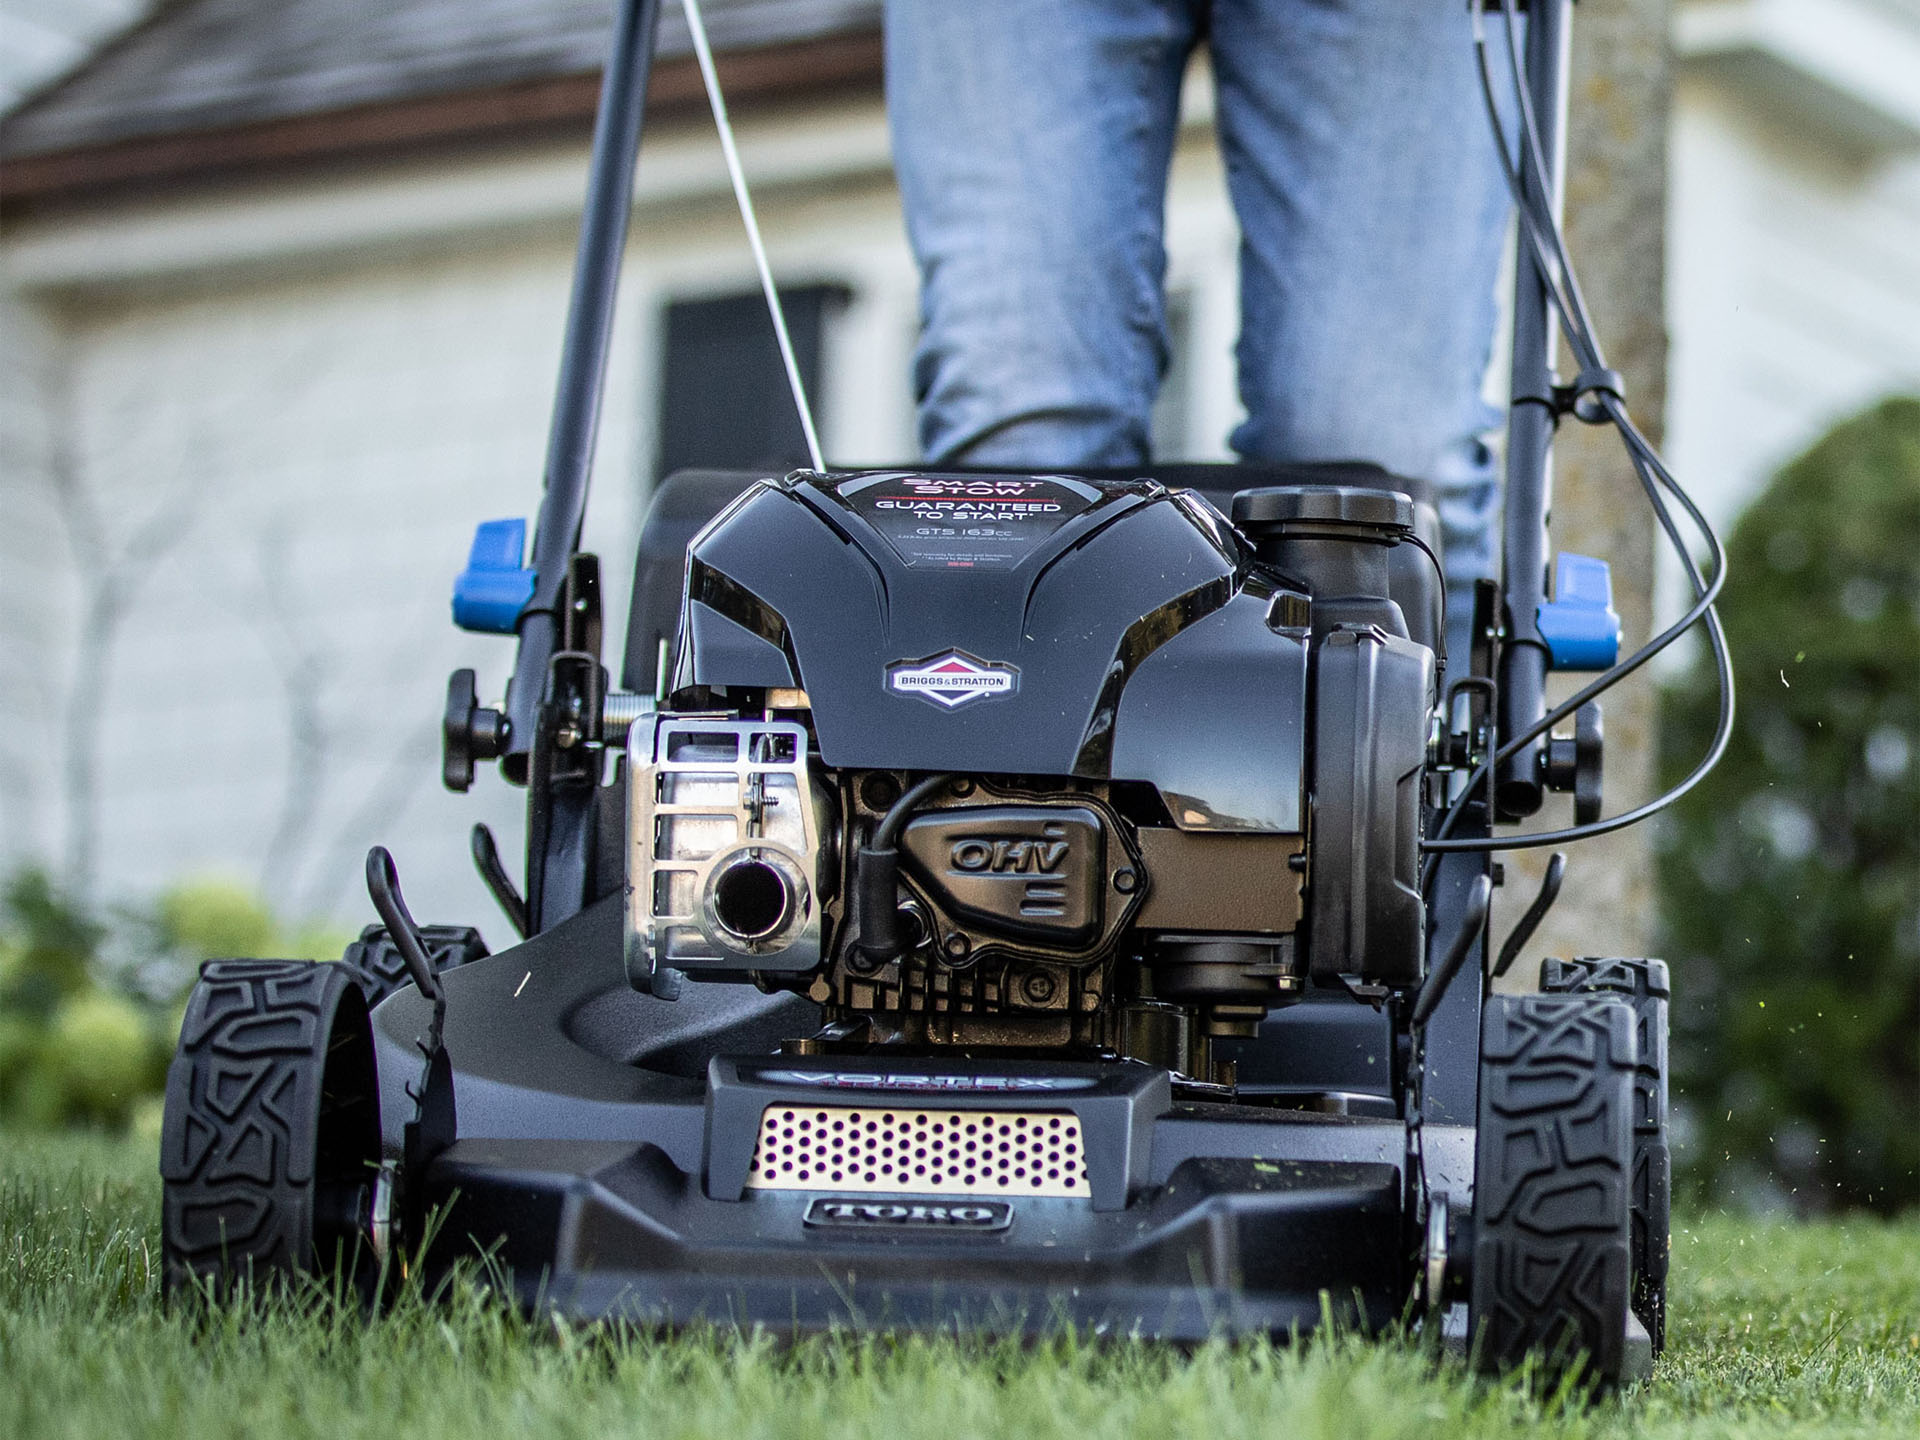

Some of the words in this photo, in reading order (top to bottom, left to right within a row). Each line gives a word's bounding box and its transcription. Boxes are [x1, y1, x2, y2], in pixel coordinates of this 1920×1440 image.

[903, 478, 1044, 487] SMART
[914, 486, 1026, 496] STOW
[875, 501, 1062, 512] GUARANTEED
[913, 511, 944, 520] TO
[916, 528, 955, 536] GTS
[962, 529, 1013, 537] 163cc
[952, 838, 1070, 874] OHV
[789, 1072, 1055, 1088] VORTEX
[823, 1203, 994, 1223] TORO
